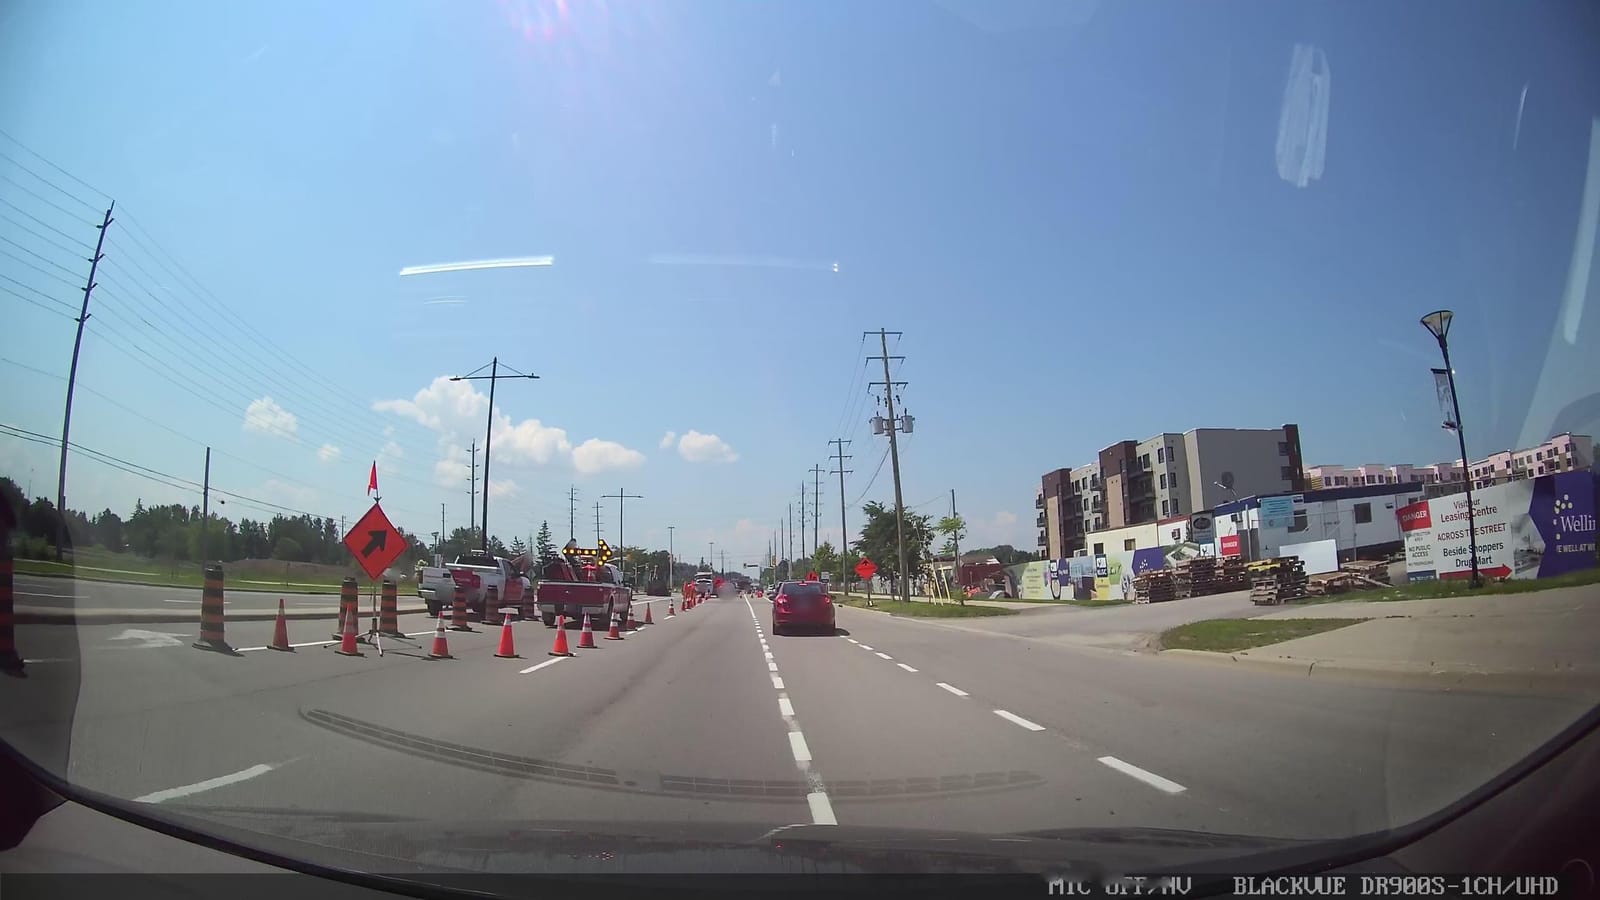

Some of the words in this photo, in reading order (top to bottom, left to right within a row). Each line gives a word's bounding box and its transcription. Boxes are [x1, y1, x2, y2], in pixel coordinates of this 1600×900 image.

[1453, 499, 1468, 510] Visit
[1441, 510, 1471, 523] Leasing
[1472, 505, 1498, 518] Centre
[1437, 529, 1464, 542] ACROSS
[1464, 528, 1479, 537] TE
[1480, 522, 1506, 535] STREET
[1443, 546, 1467, 557] Beside
[1455, 557, 1473, 568] Drug
[1476, 555, 1493, 565] Mart
